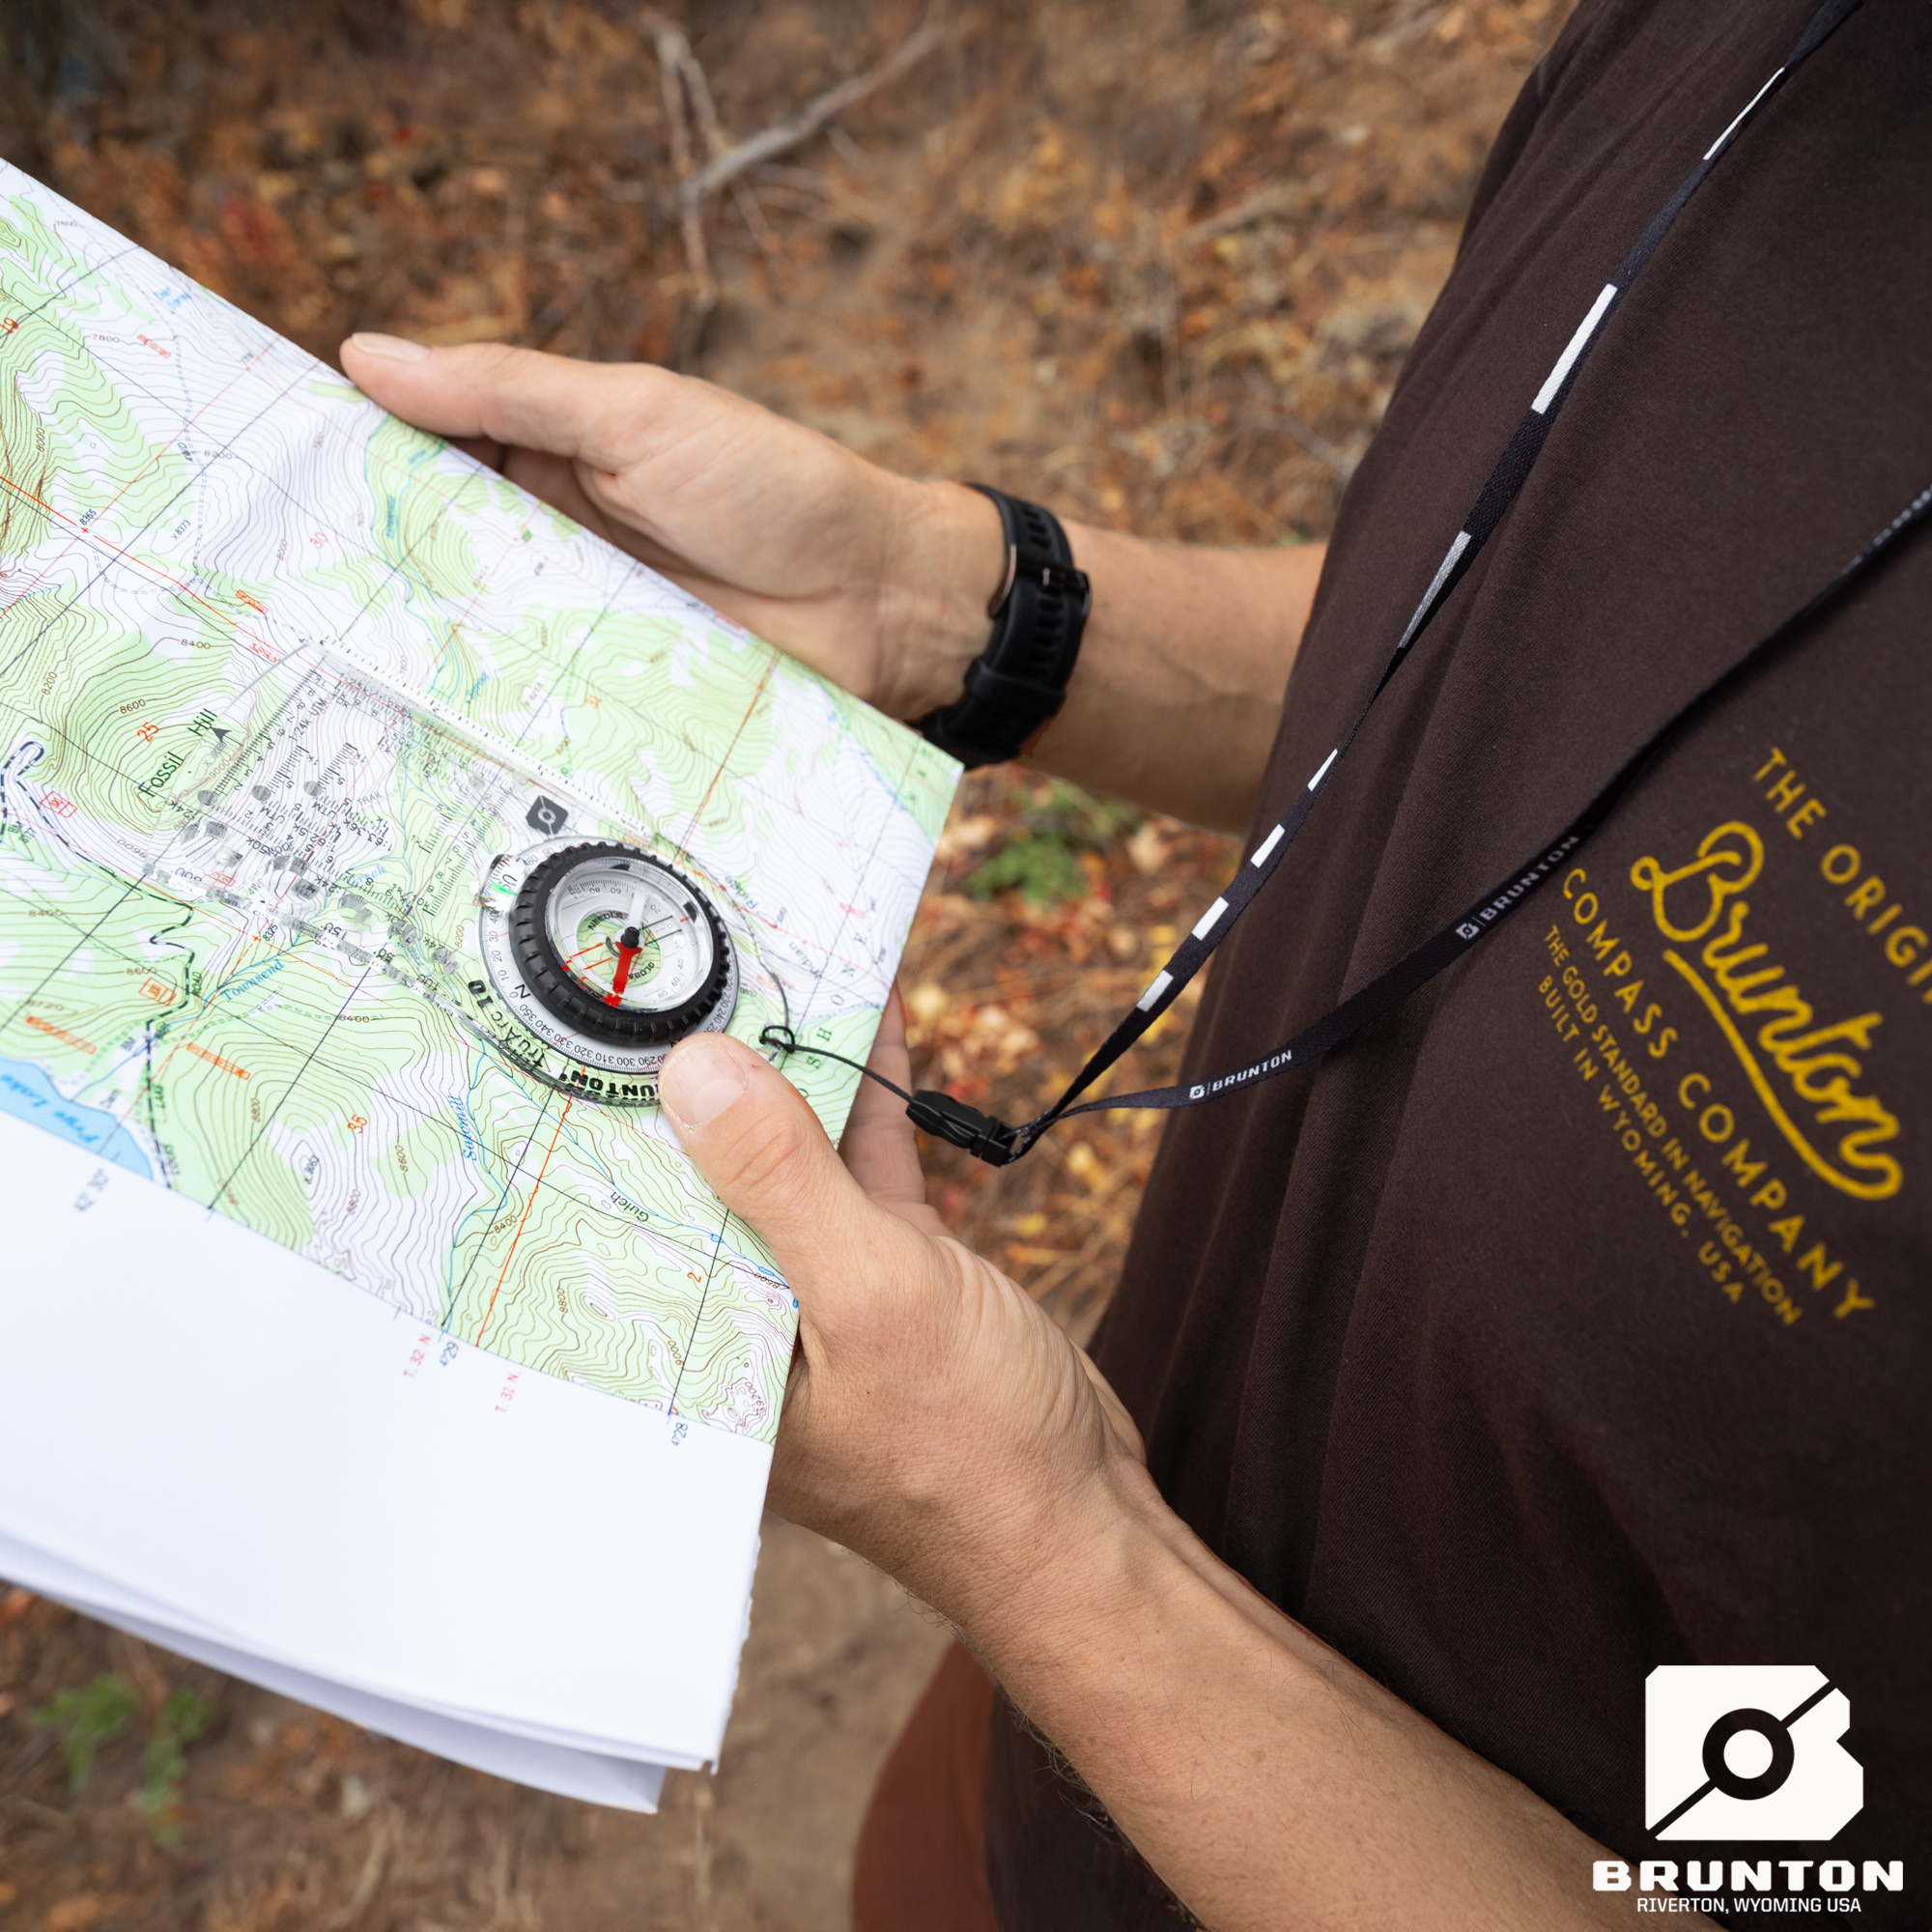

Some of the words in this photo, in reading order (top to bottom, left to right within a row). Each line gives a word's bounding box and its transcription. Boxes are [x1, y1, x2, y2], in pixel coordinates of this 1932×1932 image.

[91, 334, 121, 344] 7800
[36, 427, 45, 453] 8000
[203, 450, 233, 460] 8200
[79, 508, 98, 526] 8365
[175, 519, 192, 536] 8373
[276, 539, 289, 561] 8000
[309, 532, 328, 550] 30
[181, 639, 212, 650] 8400
[40, 670, 58, 696] 8200
[119, 698, 147, 715] 8600
[136, 721, 159, 743] 25
[137, 751, 185, 798] Fossil
[186, 707, 218, 738] Hill
[208, 757, 231, 780] 9000
[1753, 747, 1827, 839] THE
[1479, 837, 1579, 921] BRUNTON
[262, 923, 280, 943] 8325
[454, 924, 466, 949] 8200
[488, 930, 498, 943] 30
[491, 950, 502, 962] 20
[219, 958, 286, 1002] Townsend
[497, 969, 510, 981] 10
[468, 979, 494, 1009] 10
[516, 983, 531, 999] N
[721, 992, 732, 1009] 230
[338, 1013, 370, 1024] 8400
[521, 1003, 538, 1022] 350
[713, 1008, 727, 1025] 240
[1630, 820, 1903, 1201] Brunton
[534, 1019, 555, 1038] 340
[490, 1010, 546, 1068] TruArc
[553, 1032, 575, 1049] 330
[573, 1044, 595, 1058] 320
[594, 1052, 615, 1063] 310
[615, 1056, 637, 1066] 300
[638, 1054, 659, 1065] 290
[1211, 1049, 1293, 1093] BRUNTON
[1563, 867, 1678, 1059] COMPASS
[1678, 1072, 1875, 1319] COMPANY
[347, 1114, 368, 1134] 35
[448, 1094, 477, 1162] Sawmill
[1545, 923, 1571, 967] THE
[1562, 966, 1599, 1023] GOLD
[1592, 1024, 1667, 1138] STANDARD
[1661, 1137, 1690, 1172] IN
[1682, 1168, 1804, 1326] NAVIGATION
[1539, 975, 1580, 1042] BUILT
[1573, 1047, 1600, 1082] IN
[1697, 1239, 1745, 1305] USA
[610, 1190, 650, 1223] Gulch
[494, 1214, 519, 1235] 8400
[686, 1271, 702, 1284] 2
[753, 1271, 781, 1291] 8600
[556, 1287, 569, 1314] 8800
[410, 1349, 426, 1366] 32
[667, 1339, 685, 1366] 9000
[745, 1380, 766, 1412] 9200
